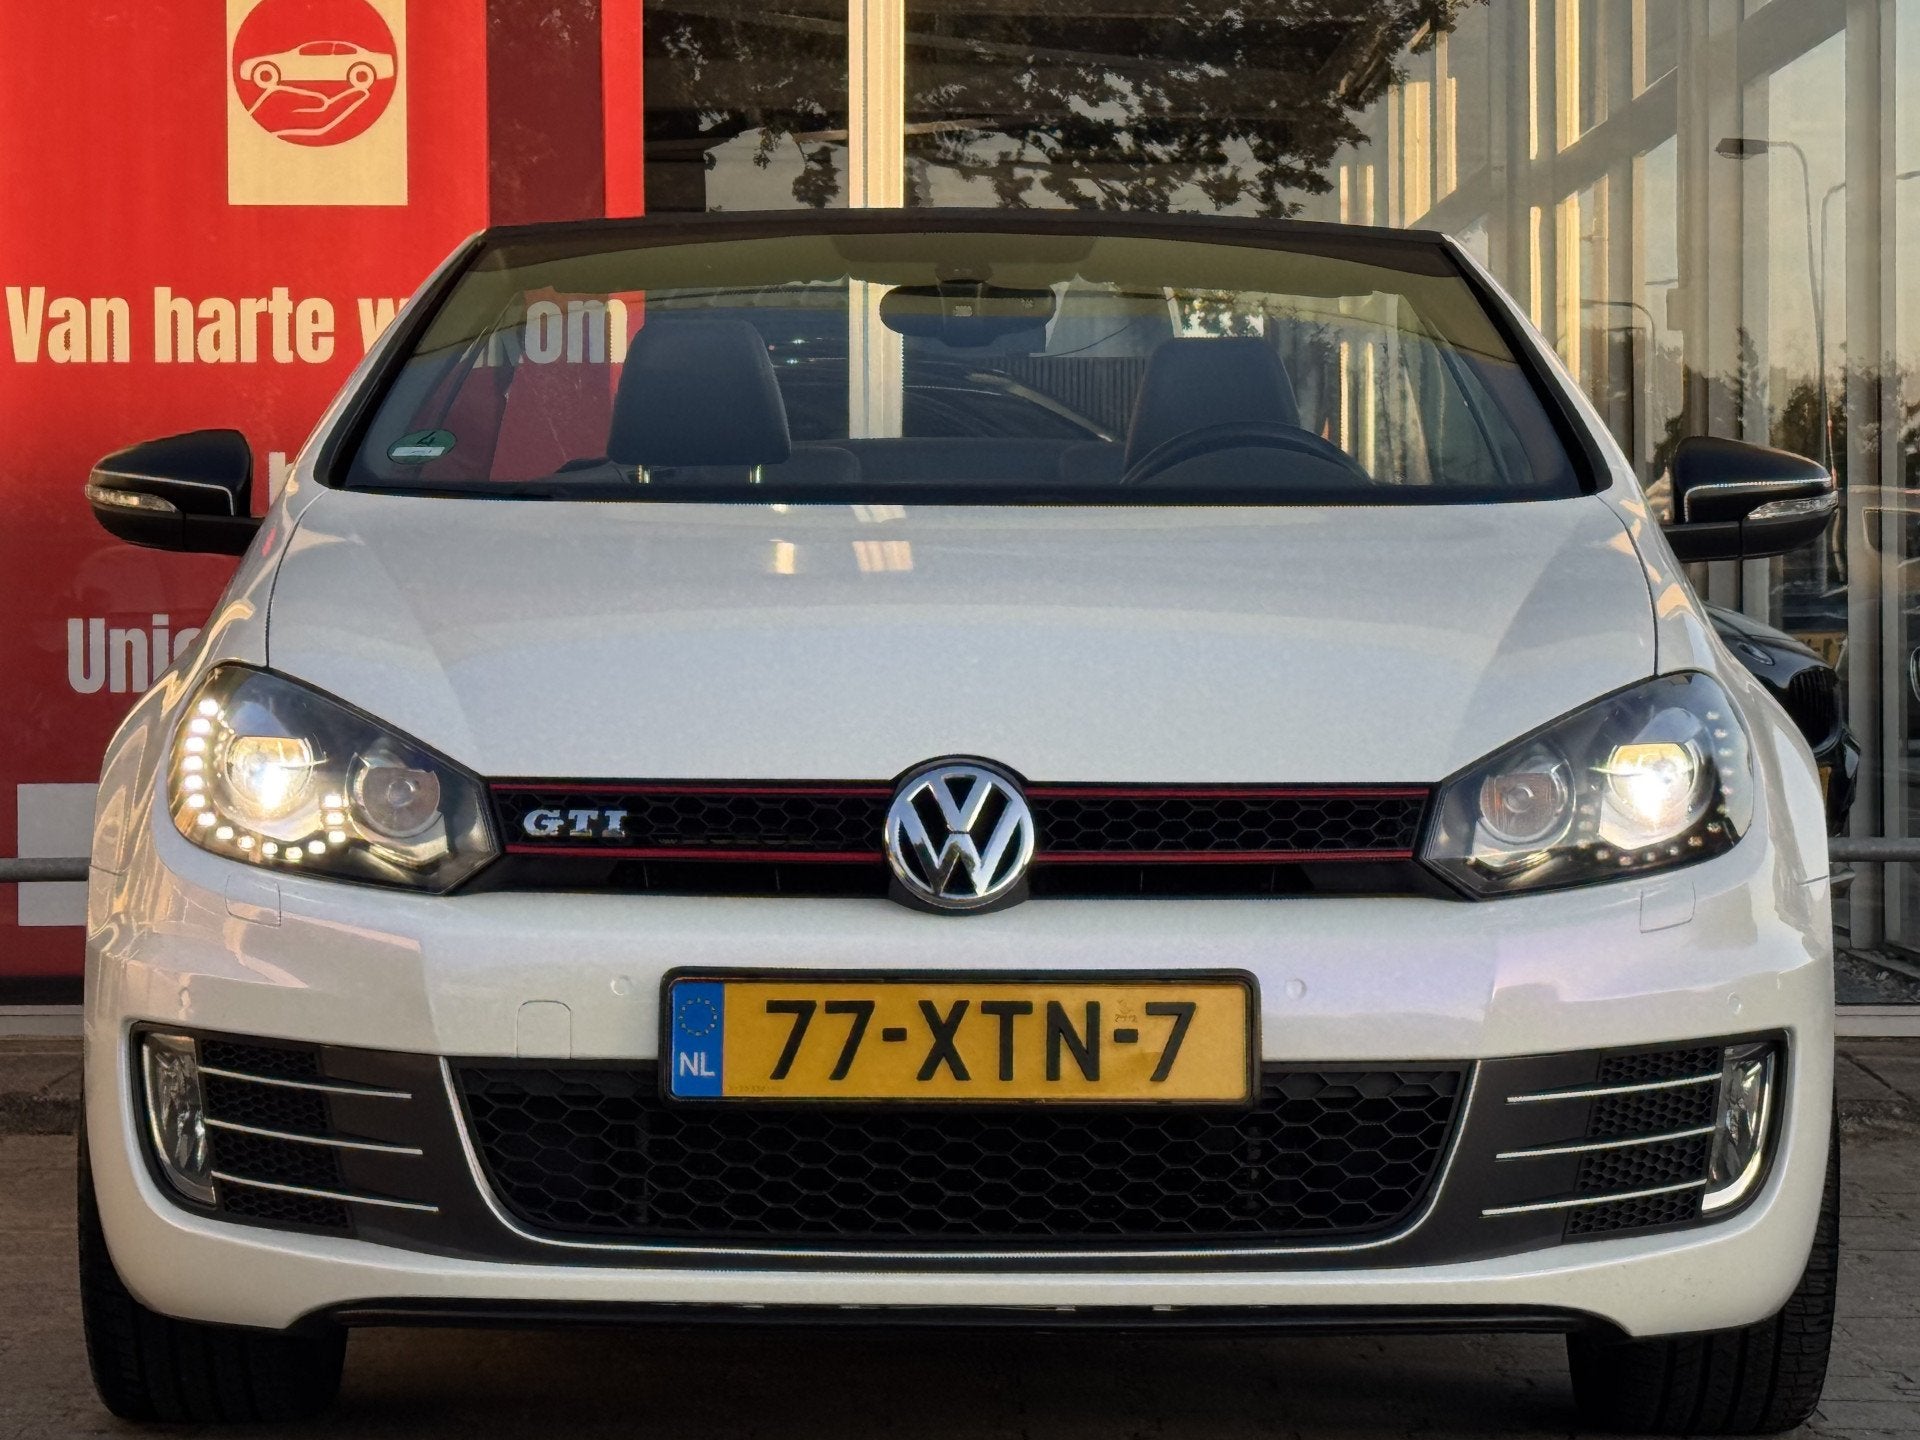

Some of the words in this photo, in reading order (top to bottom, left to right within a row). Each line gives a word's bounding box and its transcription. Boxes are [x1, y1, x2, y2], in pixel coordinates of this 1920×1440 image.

[6, 287, 129, 363] Van
[154, 287, 335, 364] harte
[523, 809, 628, 838] GTI
[679, 1051, 716, 1077] NL
[766, 1000, 1197, 1081] 77-XTN-7
